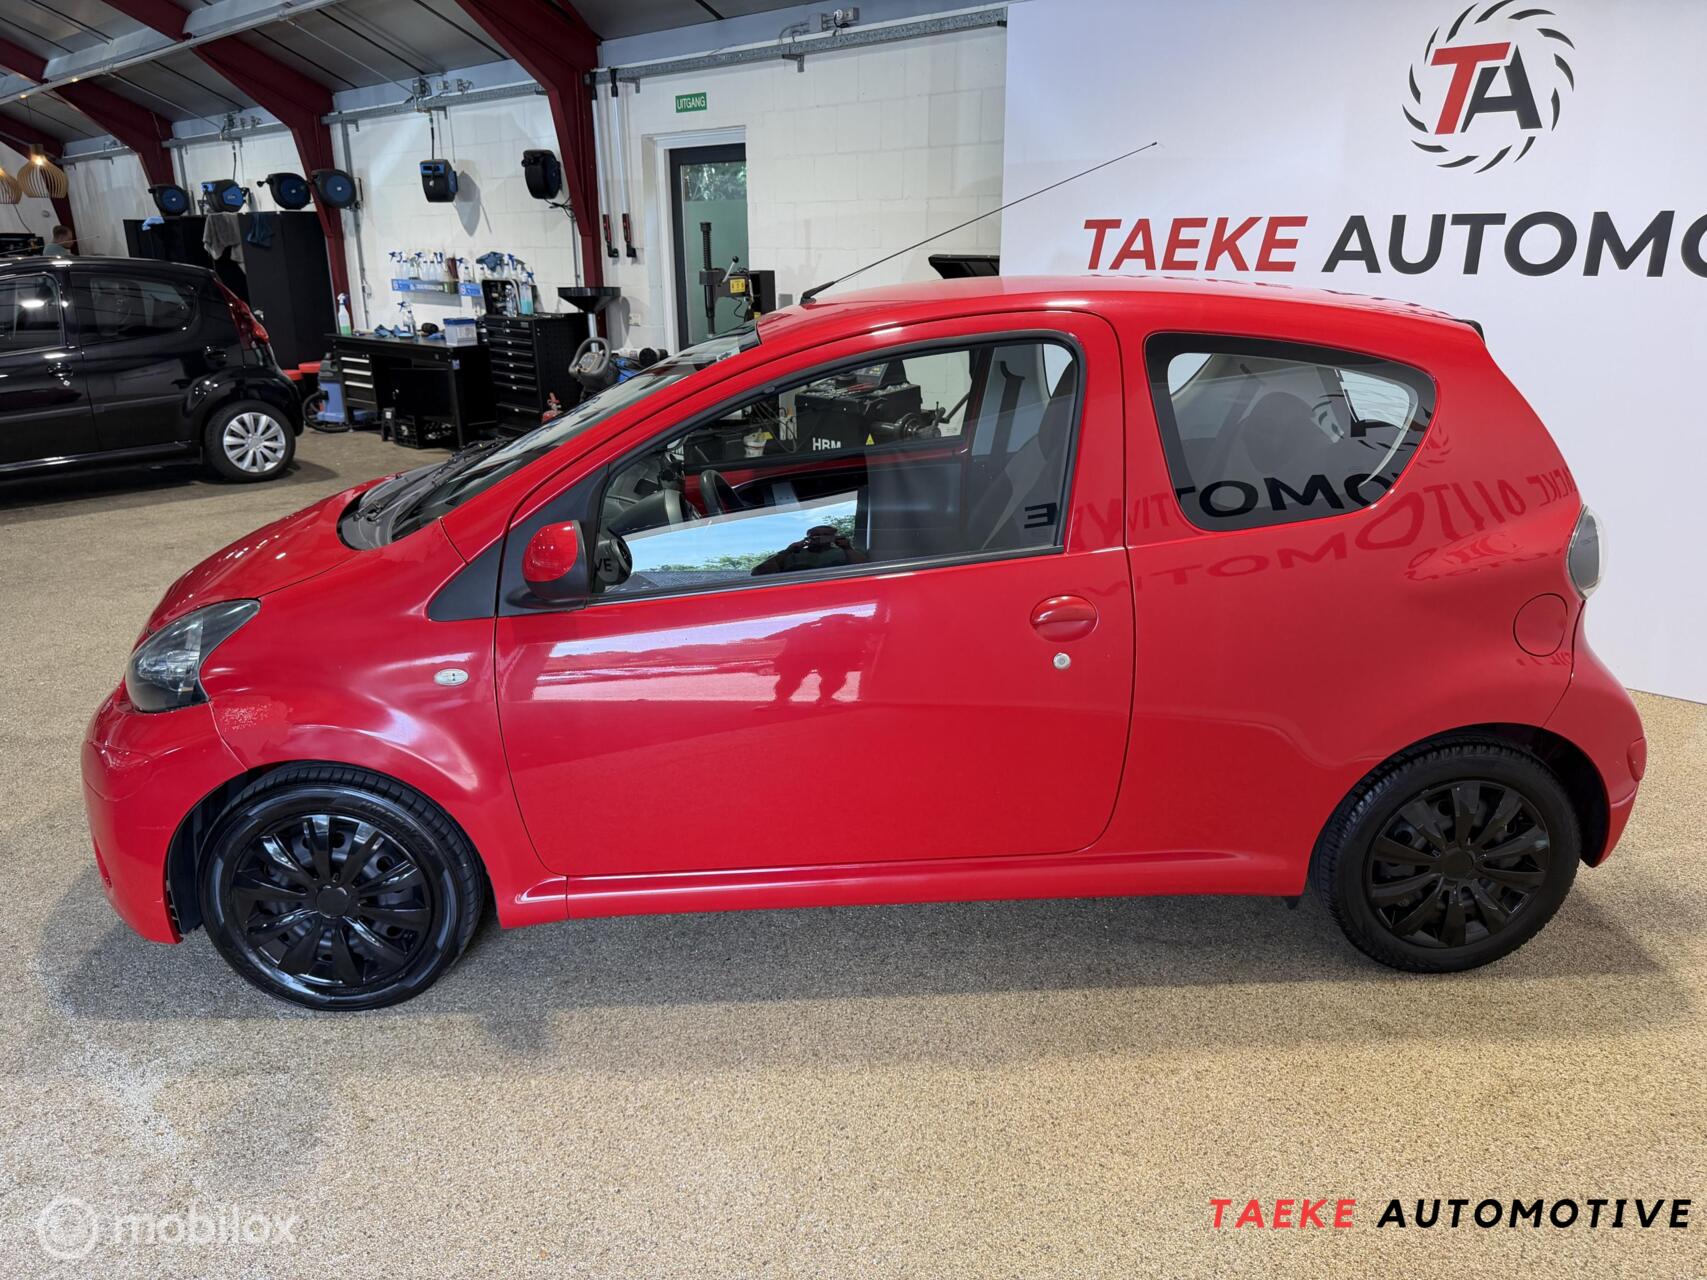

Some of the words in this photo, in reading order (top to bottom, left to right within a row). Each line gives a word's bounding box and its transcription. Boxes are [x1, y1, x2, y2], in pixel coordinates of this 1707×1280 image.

[676, 96, 706, 110] UITGANG
[1430, 41, 1543, 135] TA
[1083, 215, 1308, 273] TAEKE
